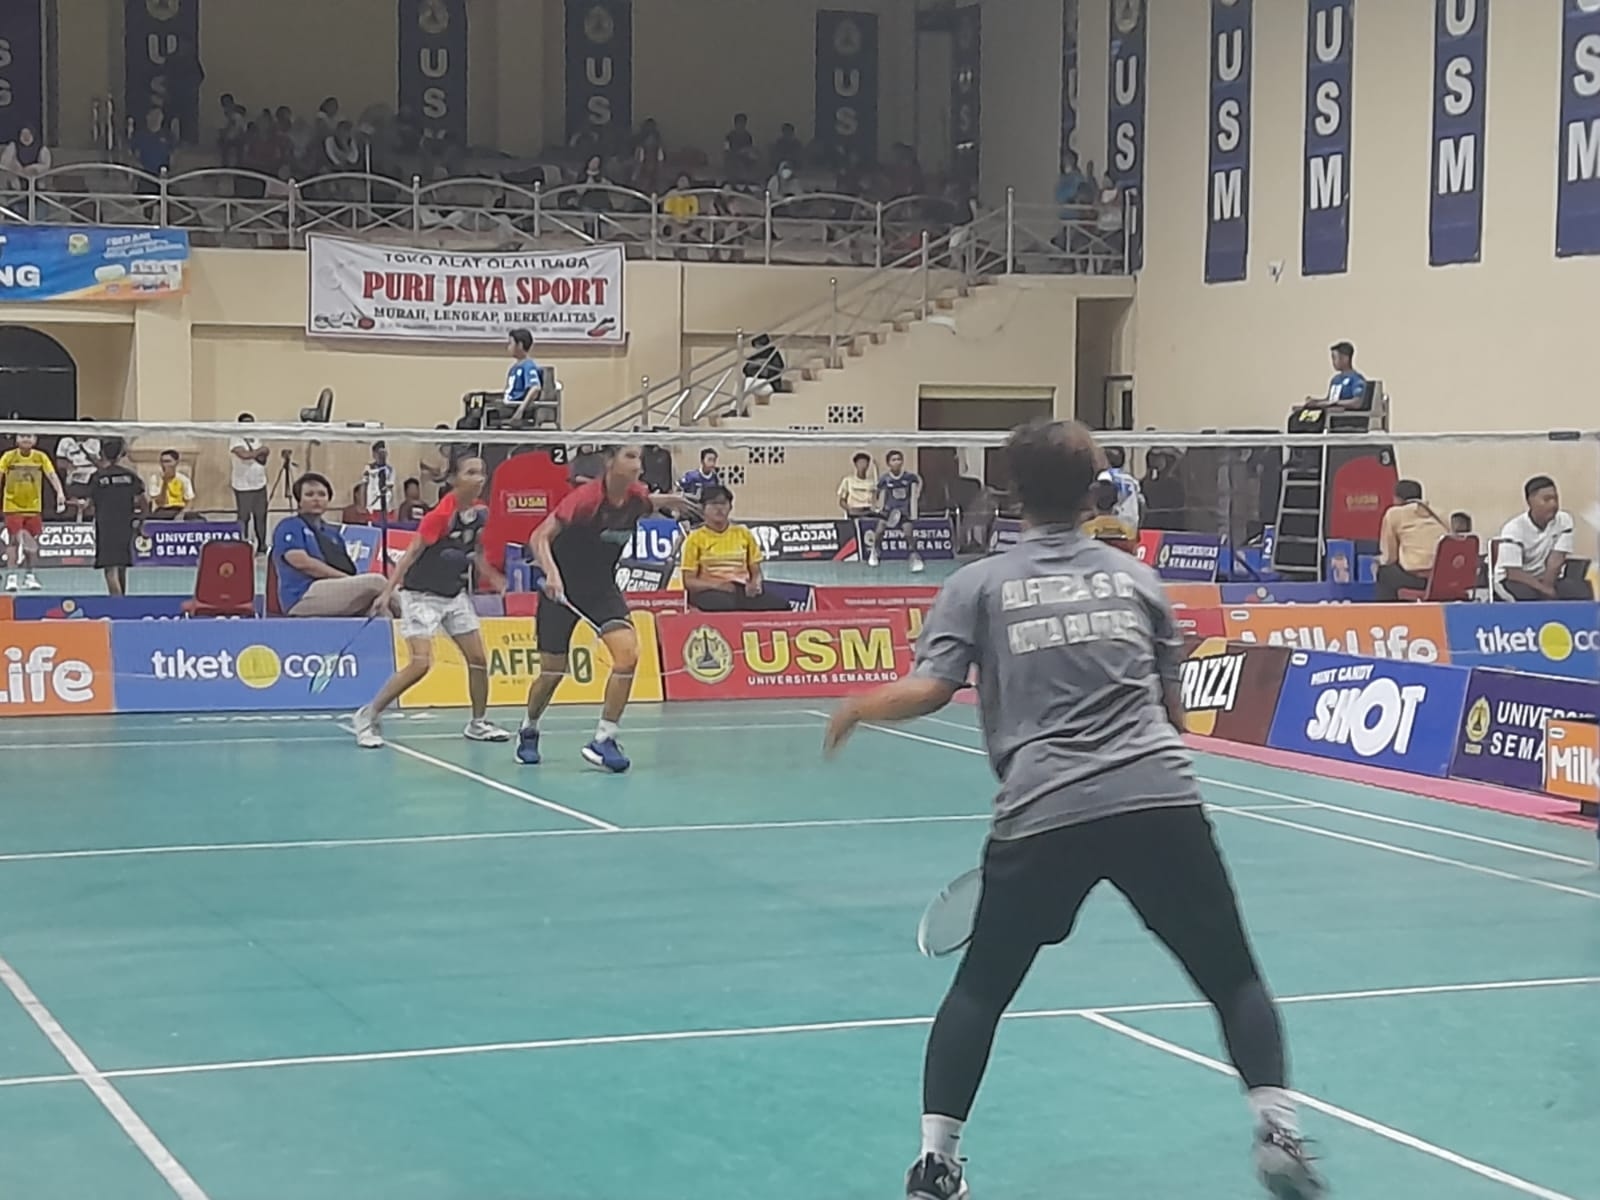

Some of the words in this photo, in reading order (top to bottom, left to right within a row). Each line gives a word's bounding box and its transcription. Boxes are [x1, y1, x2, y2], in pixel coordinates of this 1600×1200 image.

[1308, 6, 1344, 210] USM
[1436, 0, 1476, 195] USM
[1567, 0, 1600, 182] SM
[1213, 29, 1243, 221] USM
[384, 252, 433, 266] TOKO
[438, 255, 483, 269] ALAT
[487, 256, 537, 270] OLAH
[362, 270, 436, 302] PURI
[443, 275, 507, 307] JAYA
[516, 276, 609, 306] SPORT
[374, 307, 430, 323] MURAH,
[434, 309, 500, 324] LENGKAP,
[504, 311, 597, 324] BERKUALITAS
[554, 449, 565, 463] 2
[38, 533, 94, 546] GADJA
[782, 529, 837, 542] GADJAH
[743, 627, 896, 674] USM
[1475, 625, 1539, 655] tiket
[0, 645, 95, 703] ife
[152, 648, 235, 680] tiket
[747, 673, 829, 686] UNIVERSITAS
[831, 671, 898, 684] SEMARANG
[1180, 653, 1247, 711] RIZZI
[1306, 677, 1427, 757] SHOT
